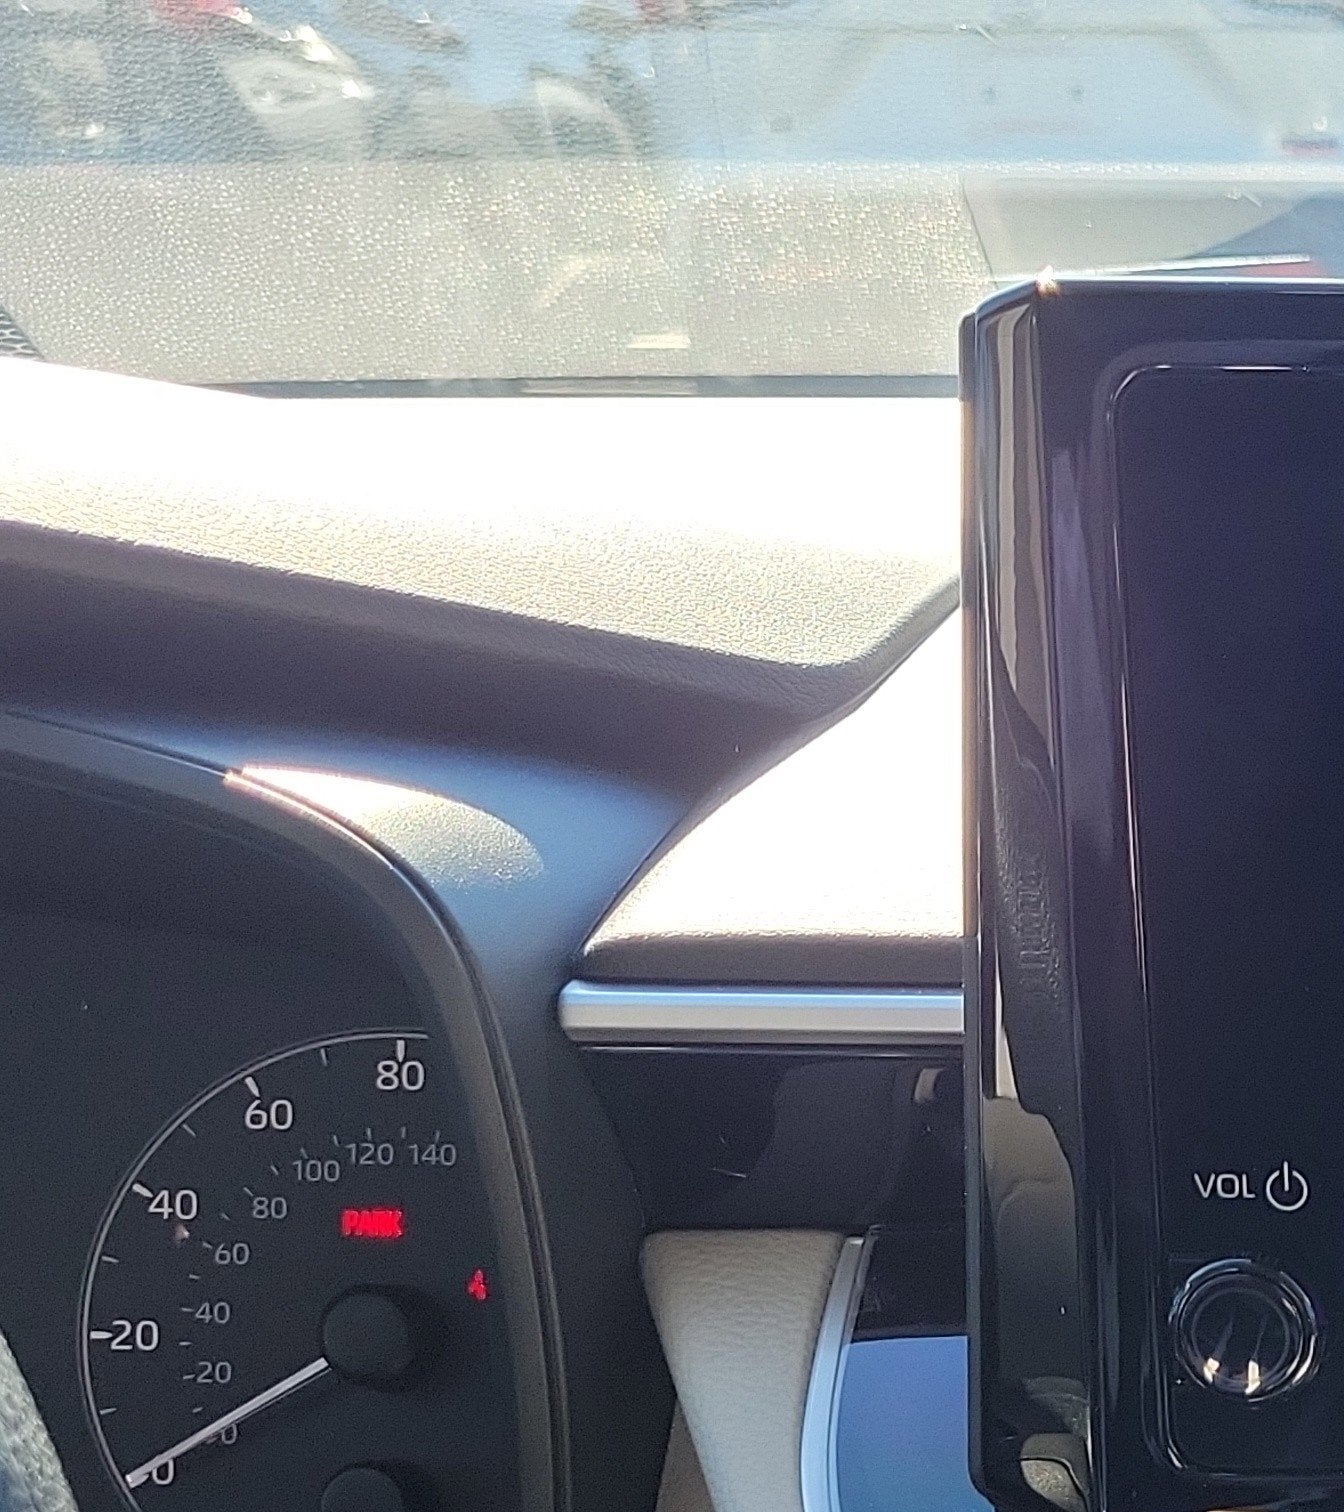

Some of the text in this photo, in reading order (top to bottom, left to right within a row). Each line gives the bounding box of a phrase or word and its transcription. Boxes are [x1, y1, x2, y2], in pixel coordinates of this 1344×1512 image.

[376, 1060, 424, 1091] 80
[244, 1099, 293, 1130] 60
[346, 1142, 394, 1166] 120
[409, 1143, 457, 1166] 140
[293, 1159, 340, 1182] 100
[1194, 1173, 1255, 1199] VOL
[148, 1189, 198, 1220] 40
[252, 1197, 287, 1219] 80
[214, 1243, 250, 1265] 60
[195, 1301, 230, 1324] 40
[111, 1320, 159, 1351] 20
[197, 1361, 232, 1384] 20
